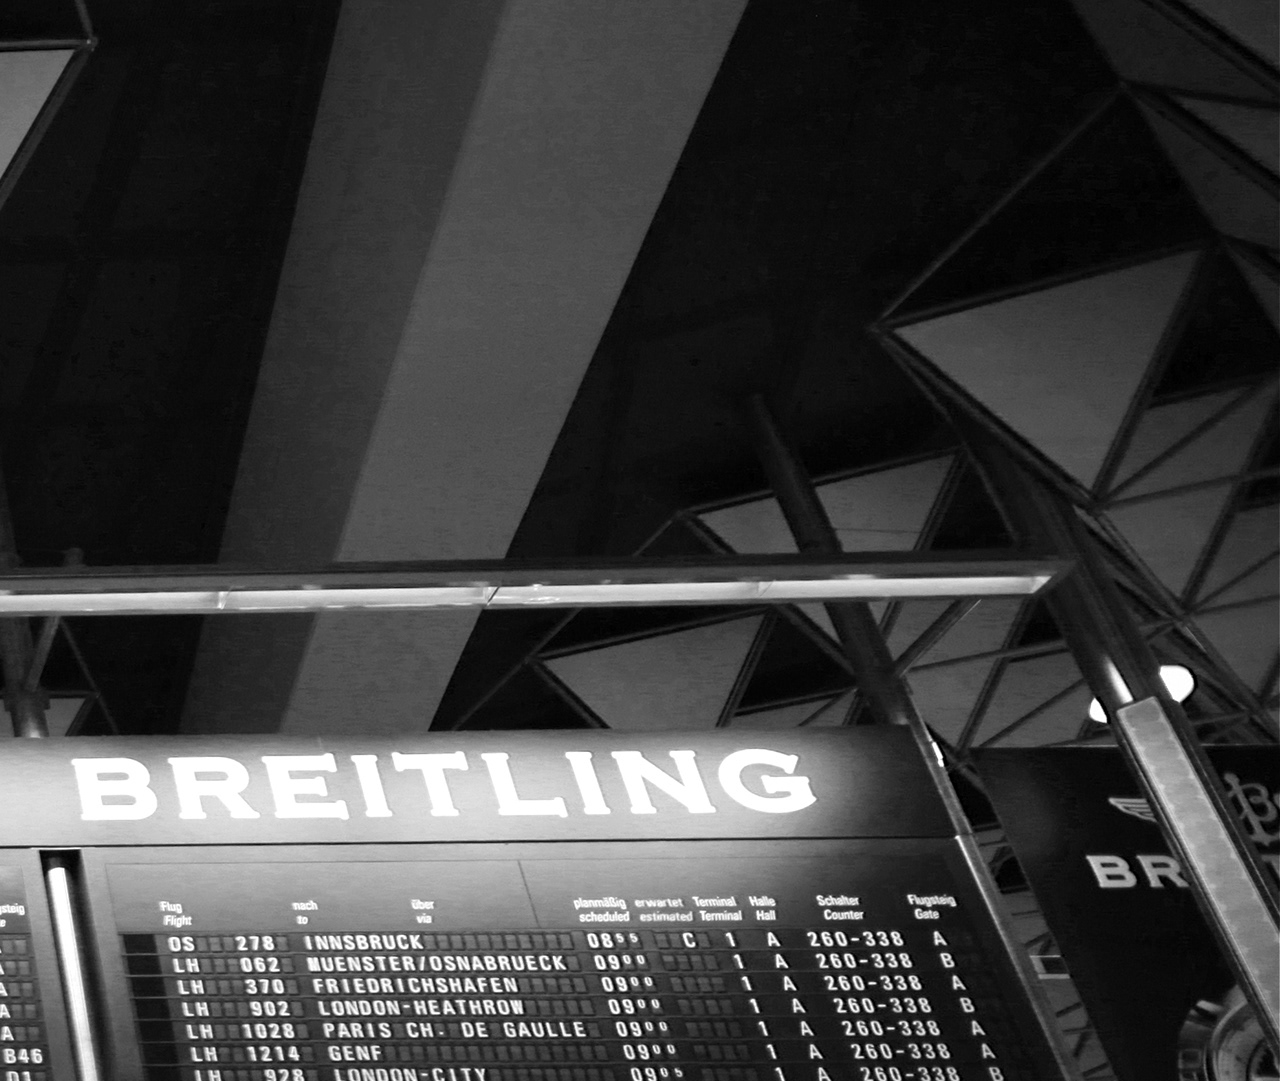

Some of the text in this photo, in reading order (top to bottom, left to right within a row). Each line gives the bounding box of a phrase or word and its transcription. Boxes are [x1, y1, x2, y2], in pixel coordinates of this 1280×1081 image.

[71, 748, 818, 820] BREITLING
[168, 931, 903, 952] OS 278 INNSBRUCK 260-338
[307, 955, 566, 972] MUENSTER/OSNABRUECK
[313, 977, 518, 993] FRIEDRICHSHAFEN
[3, 1048, 43, 1064] B46
